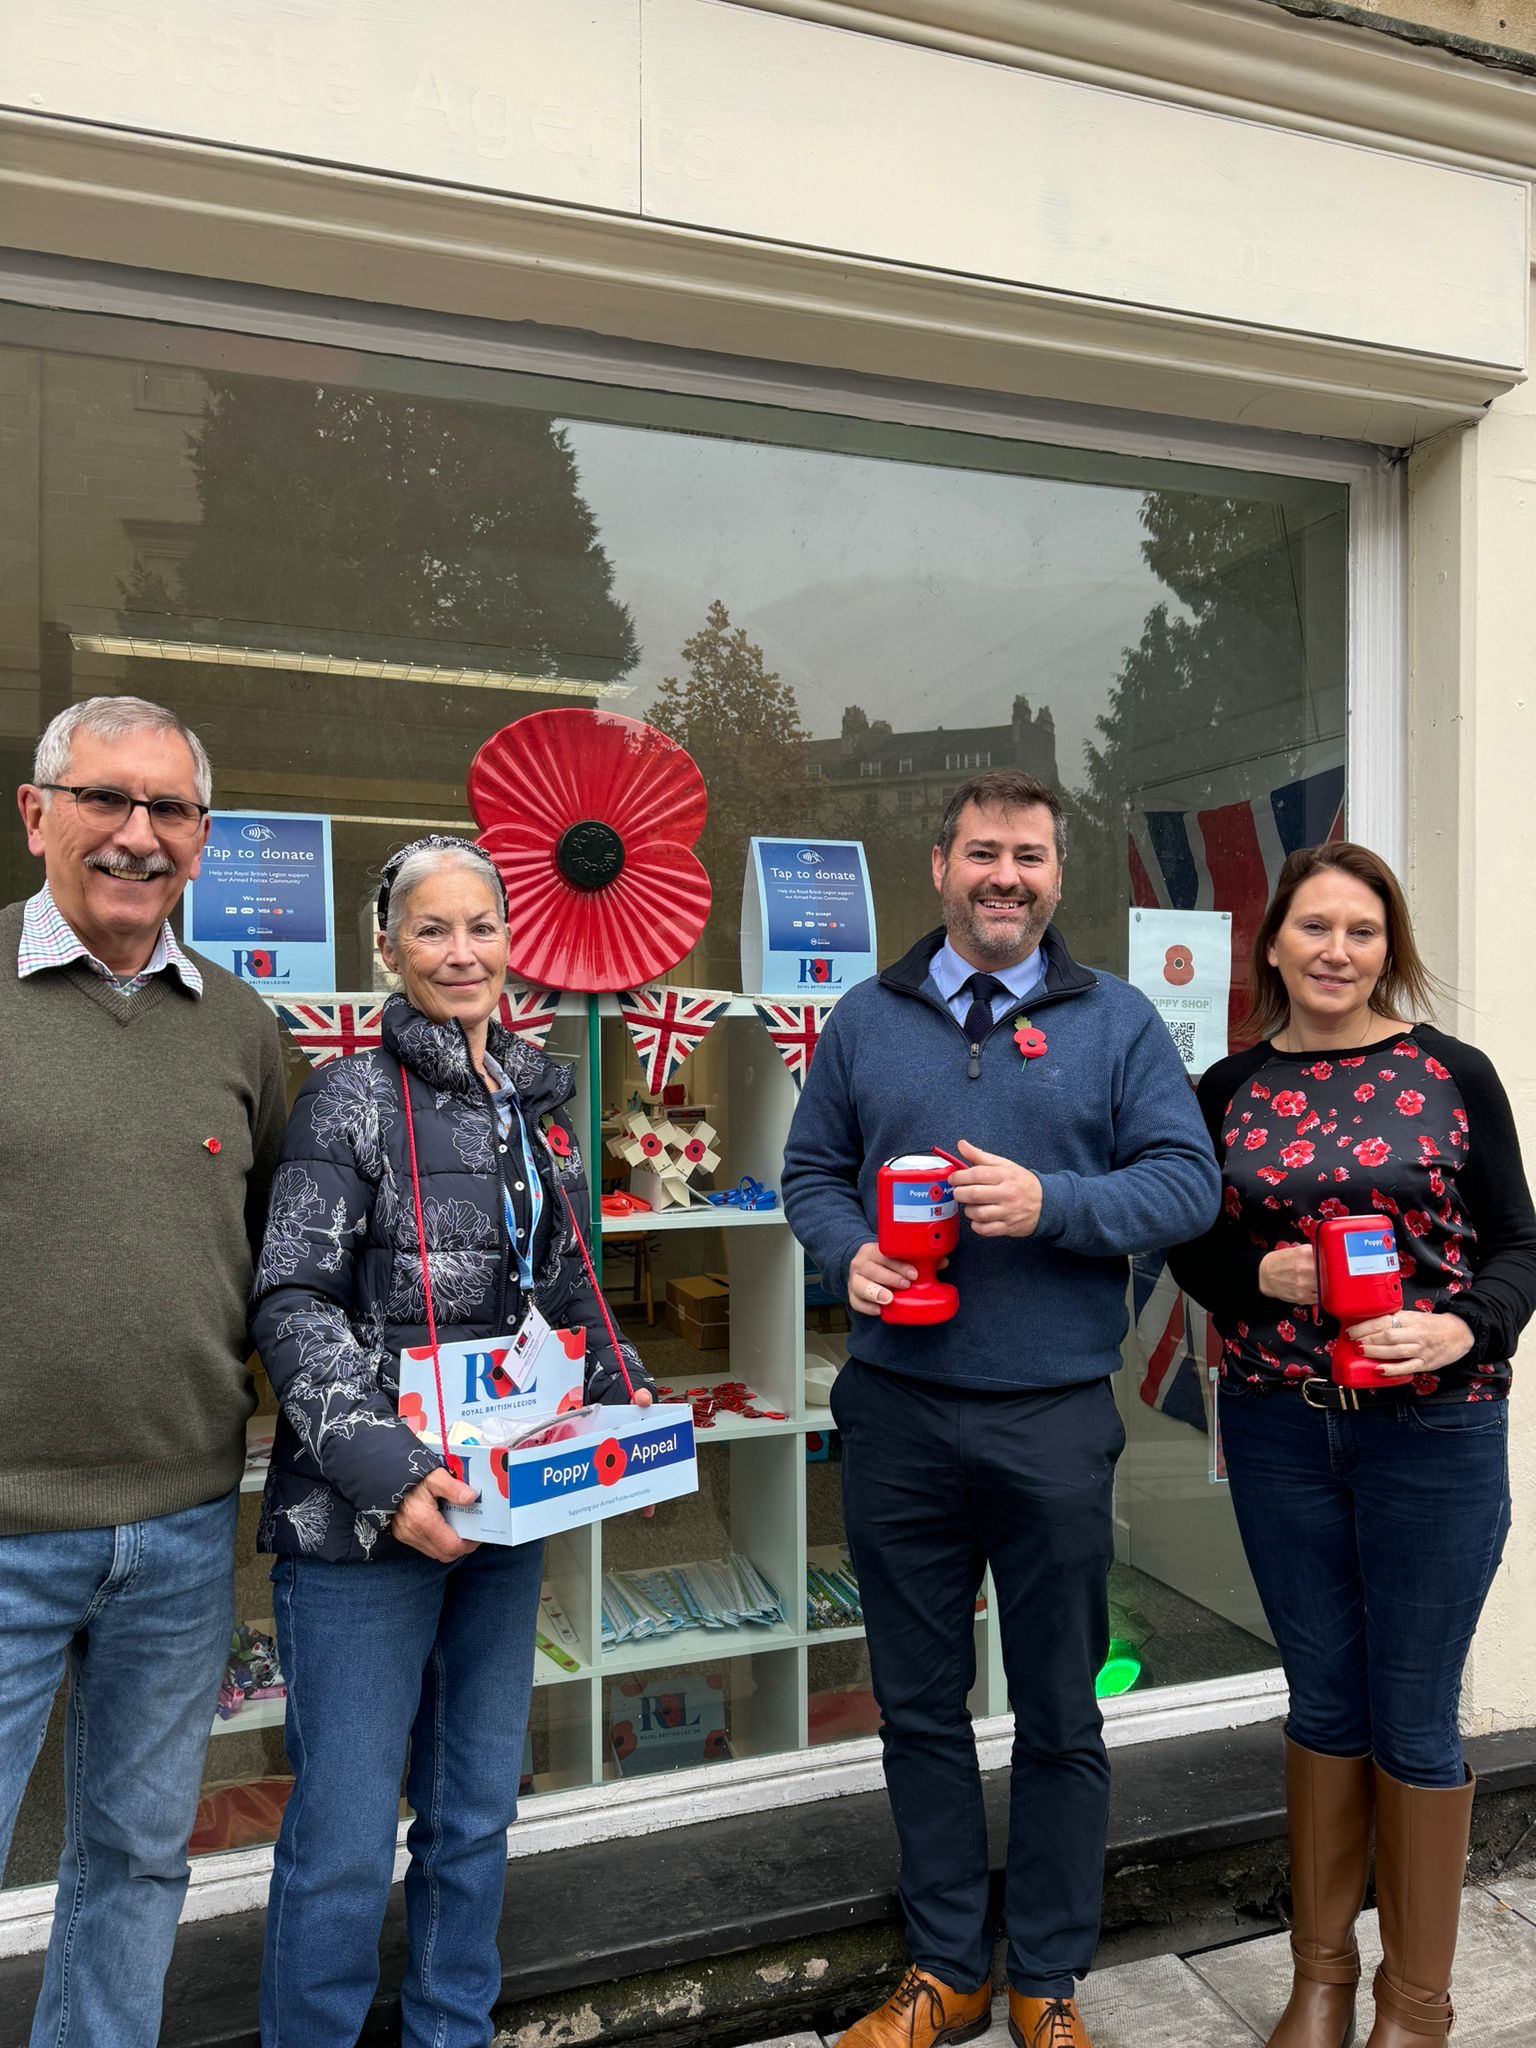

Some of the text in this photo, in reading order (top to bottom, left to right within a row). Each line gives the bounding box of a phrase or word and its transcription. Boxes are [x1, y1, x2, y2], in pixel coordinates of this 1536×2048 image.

[204, 845, 314, 861] Tap to donate
[234, 870, 249, 878] Royal
[269, 871, 287, 879] Legion
[770, 867, 856, 881] Tap to donate
[269, 877, 301, 886] Community
[1152, 998, 1210, 1009] OPPY SHOP
[909, 1189, 928, 1198] Poppy
[1364, 1239, 1383, 1247] Poppy
[461, 1398, 537, 1417] ROYAL BRITISH LEGION
[543, 1433, 677, 1486] Poppy Appeal
[567, 1504, 591, 1517] Supporting
[600, 1497, 615, 1507] Armed
